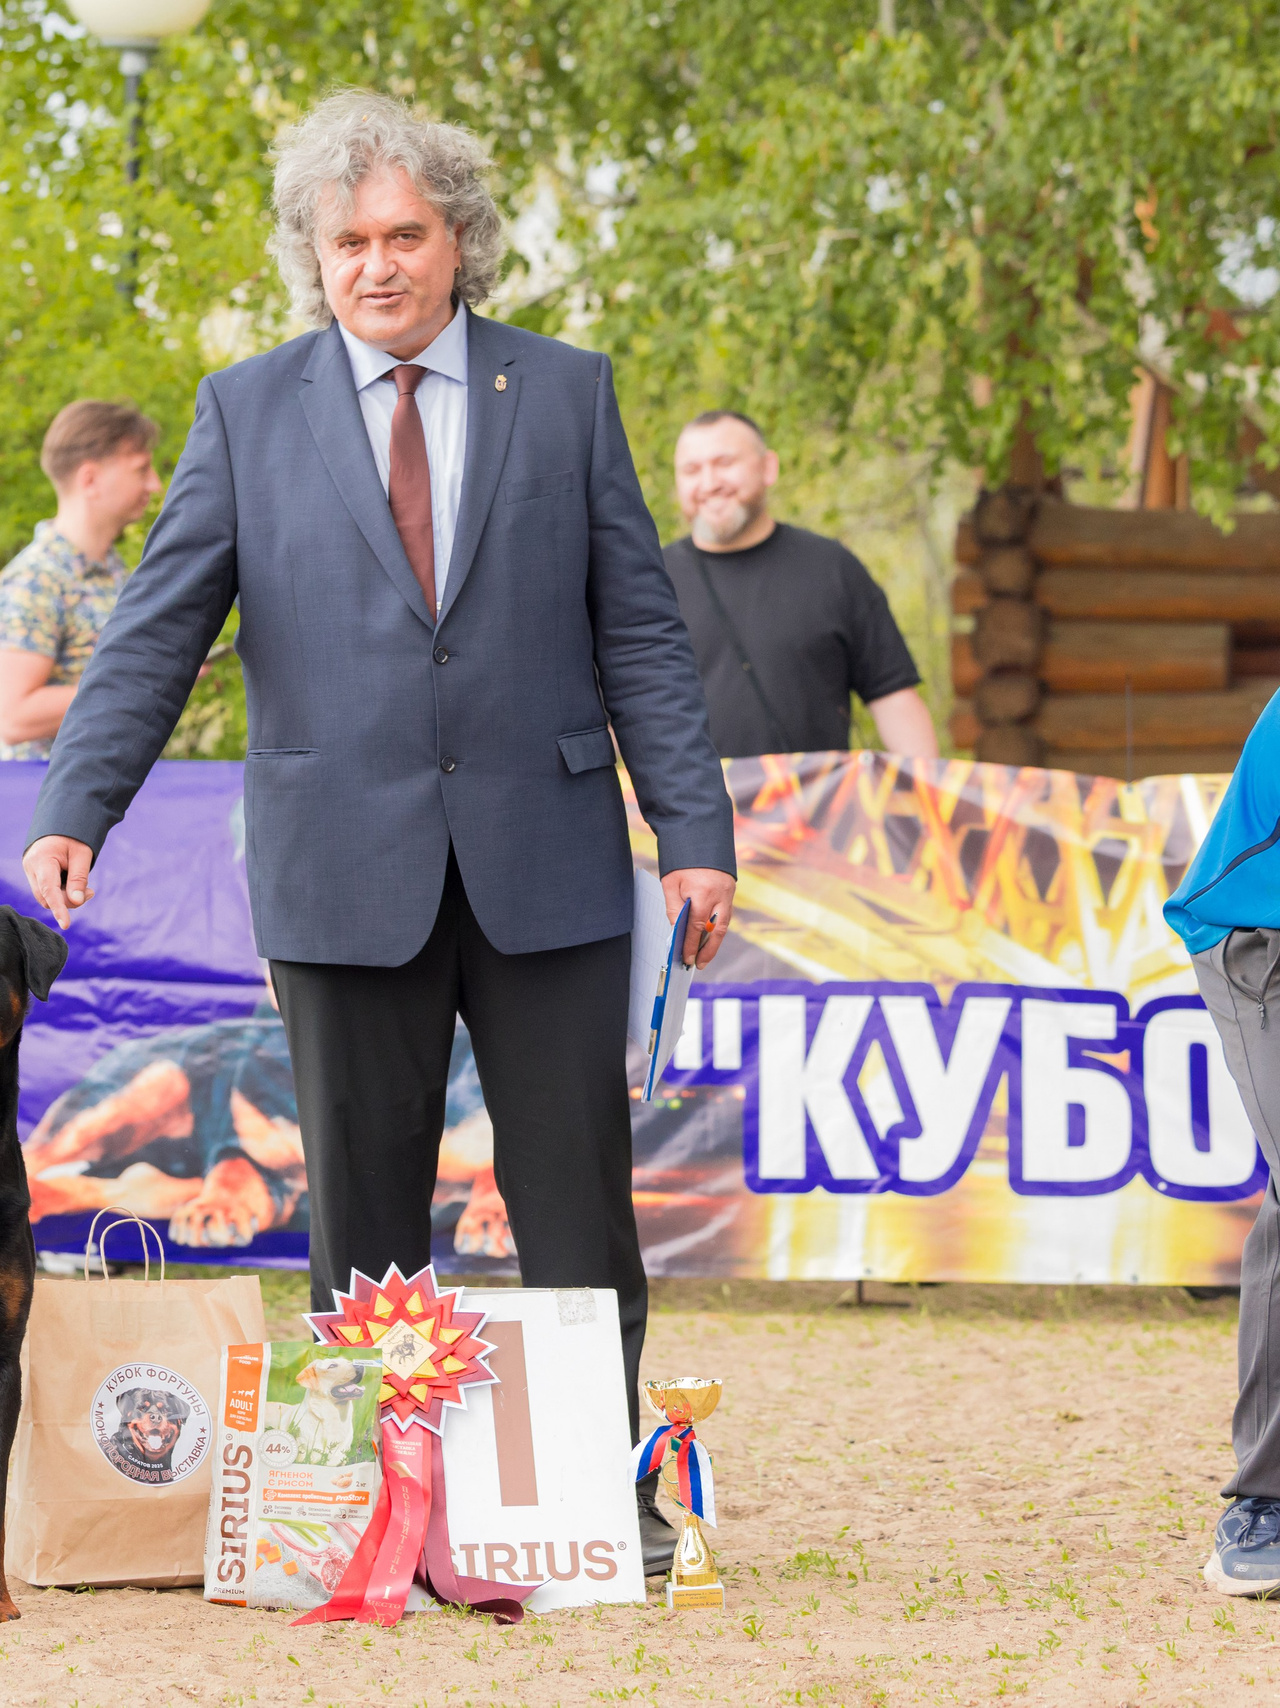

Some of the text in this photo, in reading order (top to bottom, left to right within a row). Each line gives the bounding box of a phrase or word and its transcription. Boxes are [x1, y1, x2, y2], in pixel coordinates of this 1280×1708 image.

[105, 1367, 206, 1416] КУБОК ФОРТУНЫ
[229, 1398, 254, 1412] ADULT
[477, 1320, 539, 1507] 1
[95, 1410, 160, 1481] МОНОПОРОДНАЯ
[161, 1436, 207, 1481] ВЫСТАВКА
[265, 1443, 291, 1454] 44%
[127, 1454, 151, 1468] САРАТОВ
[268, 1469, 314, 1479] ЯГНЕНОК
[277, 1479, 314, 1487] РИСОМ
[389, 1485, 412, 1575] ПОБЕДИТЕЛЬ
[213, 1587, 245, 1595] PREMIUM
[366, 1600, 401, 1609] МЕСТО
